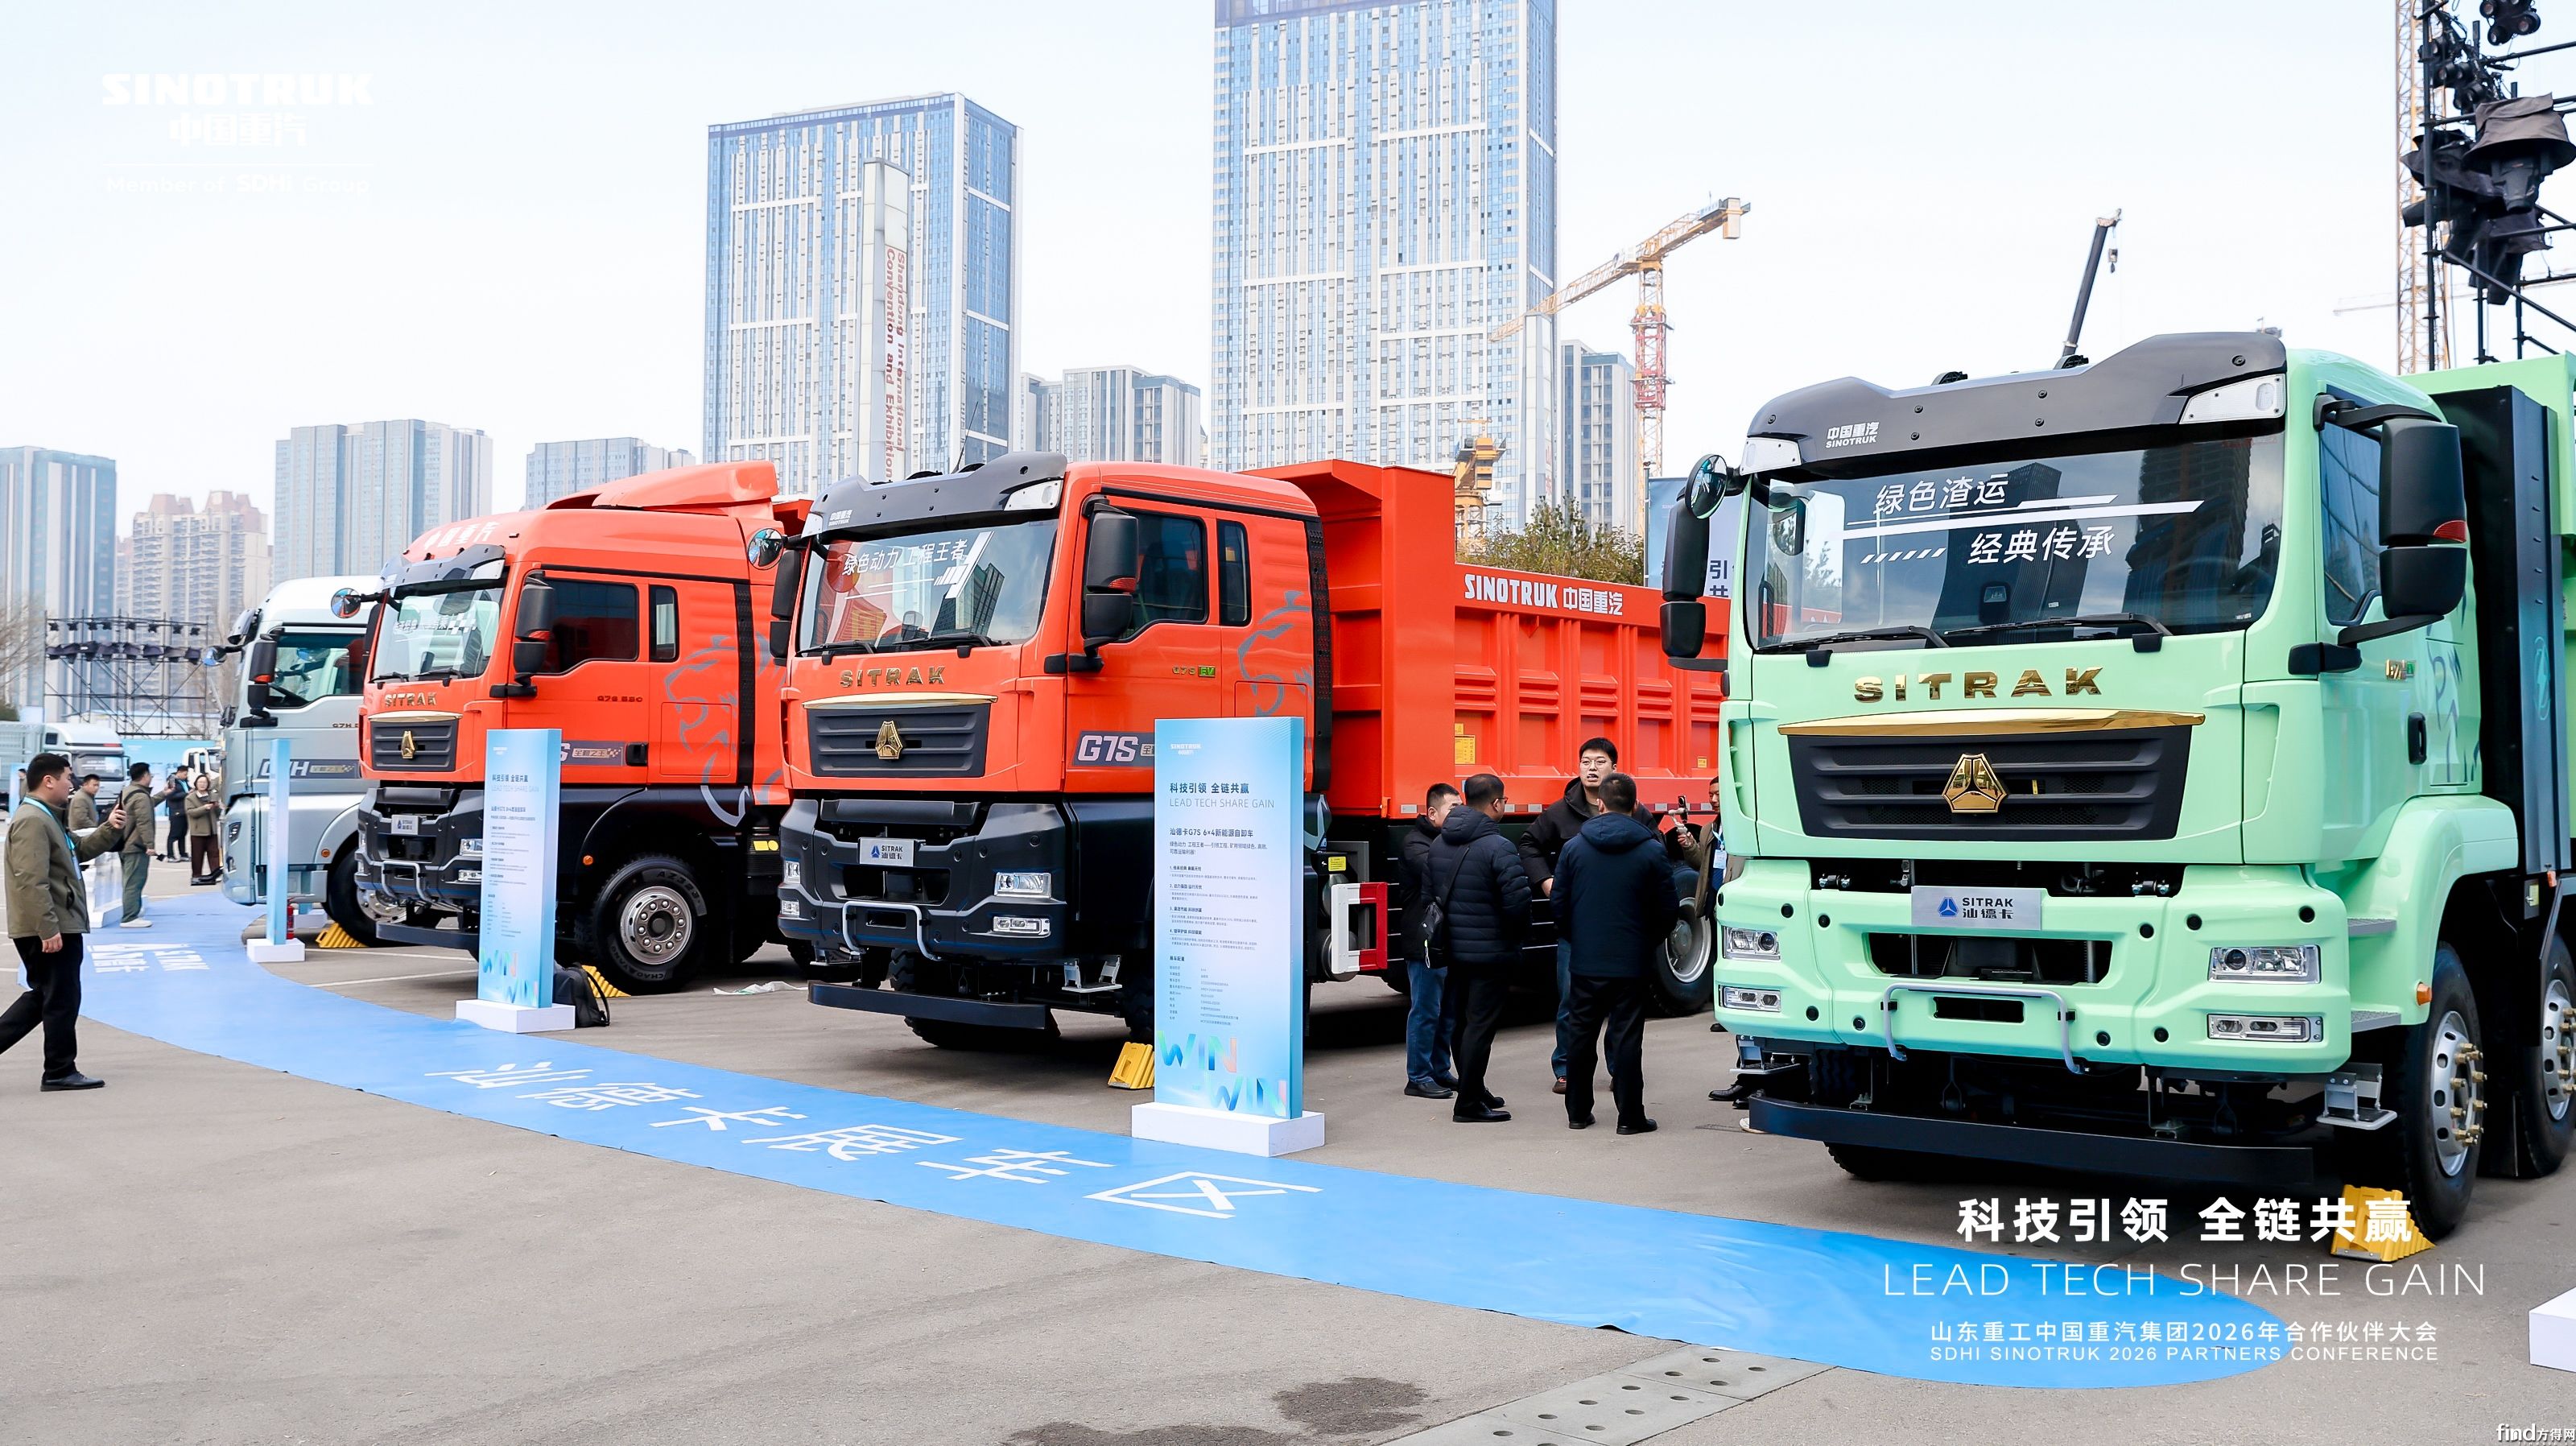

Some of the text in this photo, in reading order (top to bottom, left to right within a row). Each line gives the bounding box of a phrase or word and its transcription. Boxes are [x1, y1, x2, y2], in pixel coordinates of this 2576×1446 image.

[886, 248, 895, 344] Convention
[896, 252, 905, 452] Shandong International
[886, 394, 894, 478] Exhibition
[1826, 436, 1877, 448] SINOTRUK
[1827, 422, 1880, 440] 中国重汽
[1873, 473, 2009, 516] 绿色渣运
[842, 539, 968, 576] 绿色动力 工程王者
[1967, 525, 2116, 565] 经典传承
[1464, 573, 1623, 616] SINOTRUK 中国重汽
[840, 665, 945, 688] SITRAK
[1853, 667, 2103, 704] SITRAK
[384, 692, 437, 707] SITRAK
[1077, 735, 1139, 762] G7S
[1170, 782, 1249, 794] 科技引领 全链共赢
[1170, 798, 1274, 808] LEAD TECH SHARE GAIN
[1962, 897, 2014, 907] SITRAK
[1963, 908, 2014, 919] 汕德卡
[424, 1061, 1324, 1219] 汕德卡展车区
